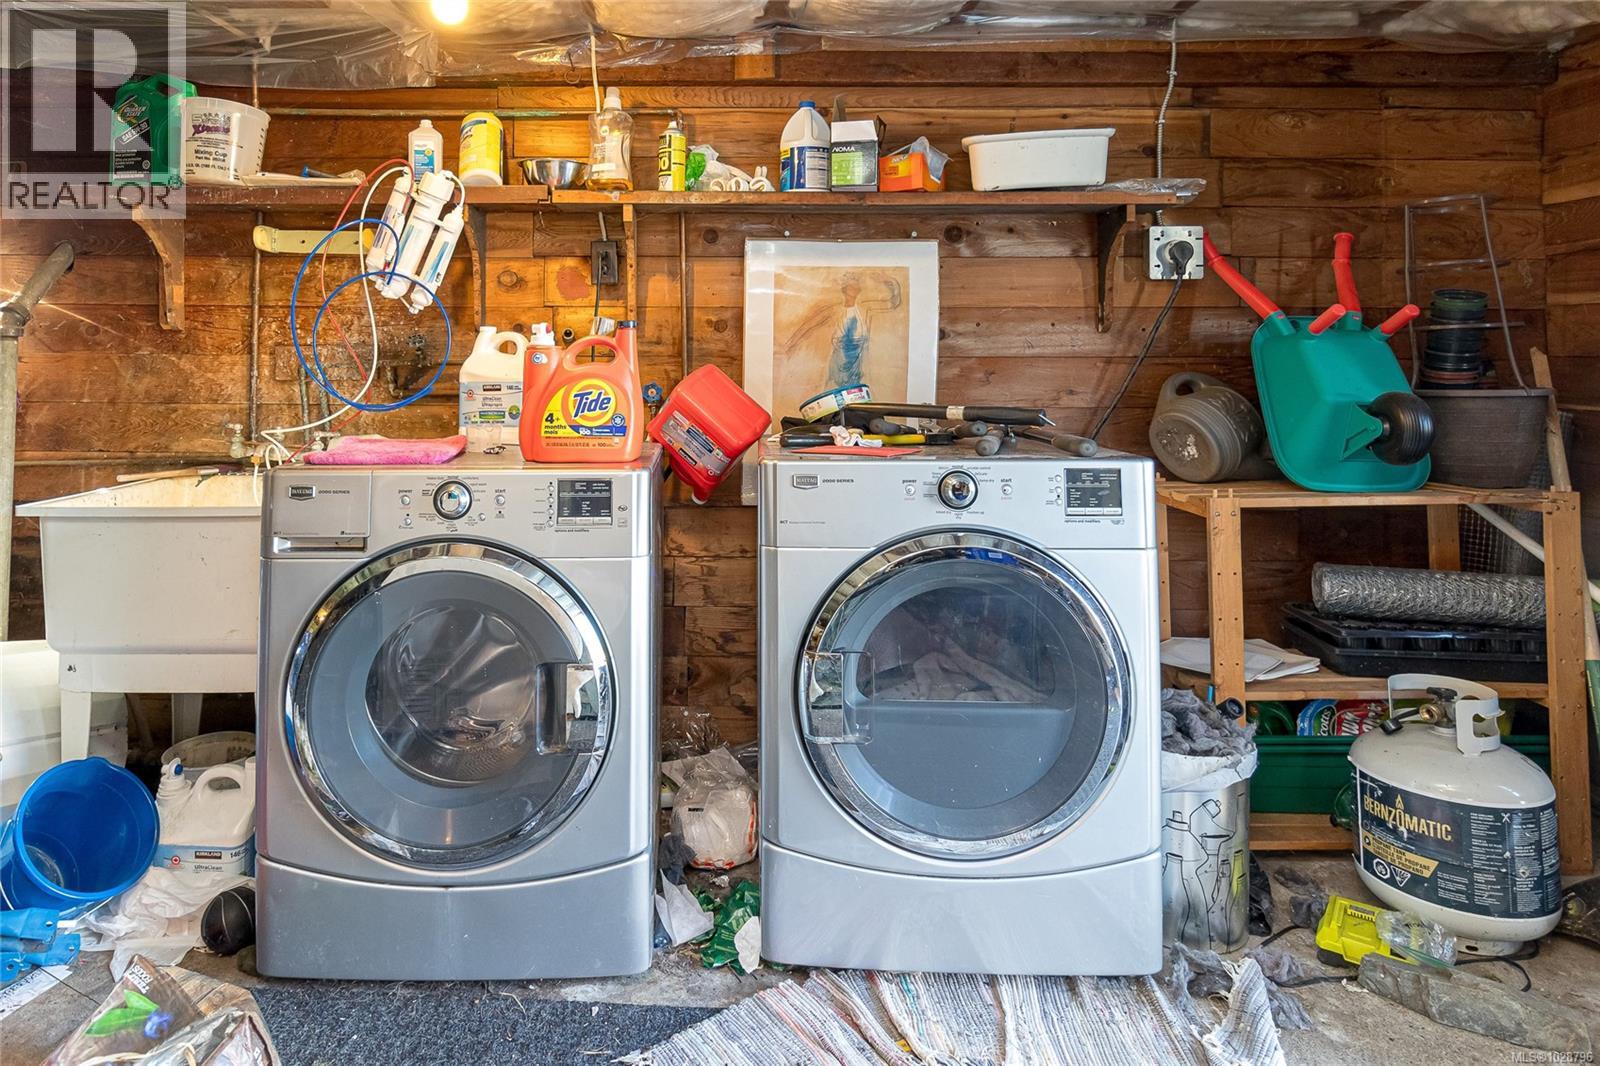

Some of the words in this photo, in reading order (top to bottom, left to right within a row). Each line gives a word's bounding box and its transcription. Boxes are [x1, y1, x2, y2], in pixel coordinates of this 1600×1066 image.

[214, 150, 228, 158] Cup
[572, 389, 612, 420] Tide
[1363, 793, 1452, 841] BERNZOMATIC
[1393, 846, 1406, 857] TANK
[1397, 860, 1424, 875] PROPANO
[1404, 856, 1431, 871] PROPANE
